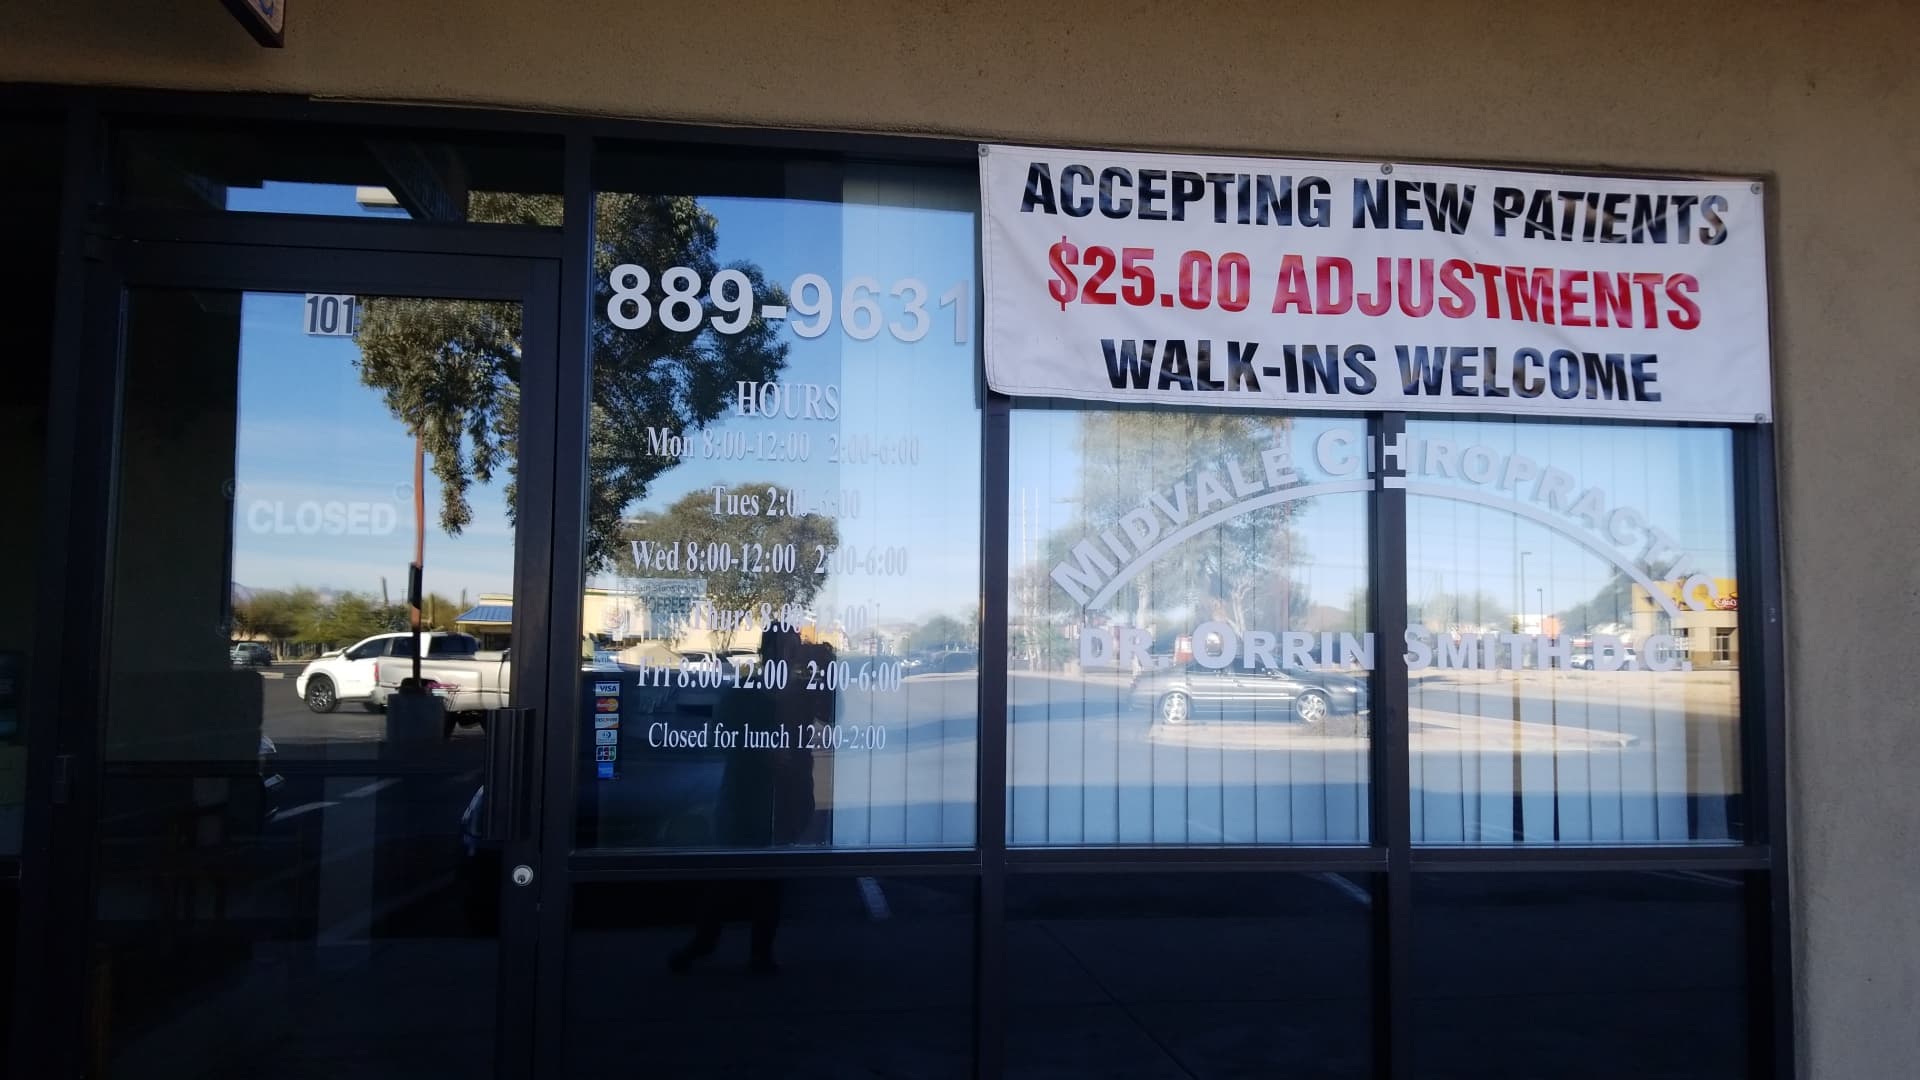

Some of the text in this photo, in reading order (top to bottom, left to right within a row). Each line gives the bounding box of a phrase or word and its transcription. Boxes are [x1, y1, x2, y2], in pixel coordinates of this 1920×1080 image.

[1020, 162, 1729, 246] ACCEPTING NEW PATIENTS
[1048, 235, 1701, 331] $25.00 ADJUSTMENTS
[306, 295, 354, 334] 101
[607, 263, 969, 344] 889-9631
[1100, 338, 1662, 402] WALK-INS WELCOME
[736, 381, 840, 421] HOURS
[647, 426, 694, 459] Mon
[702, 428, 809, 462] 8:00-12:00
[247, 499, 397, 536] CLOSED
[711, 486, 760, 516] Tues
[1050, 428, 1718, 611] MIDVALE CHIROPRACTIC
[631, 540, 679, 572] Wed
[686, 542, 796, 574] 8:00-12:00
[690, 599, 752, 632] Thurs
[760, 602, 868, 635] 8:0012:00
[1080, 627, 1169, 668] DR.
[1191, 621, 1375, 671] ORRIN
[1403, 624, 1571, 672] SMITH
[637, 656, 902, 692] Fri 8:00-12:00 2:00-6:00
[648, 722, 886, 751] Closed for lunch 12:00-2:00
